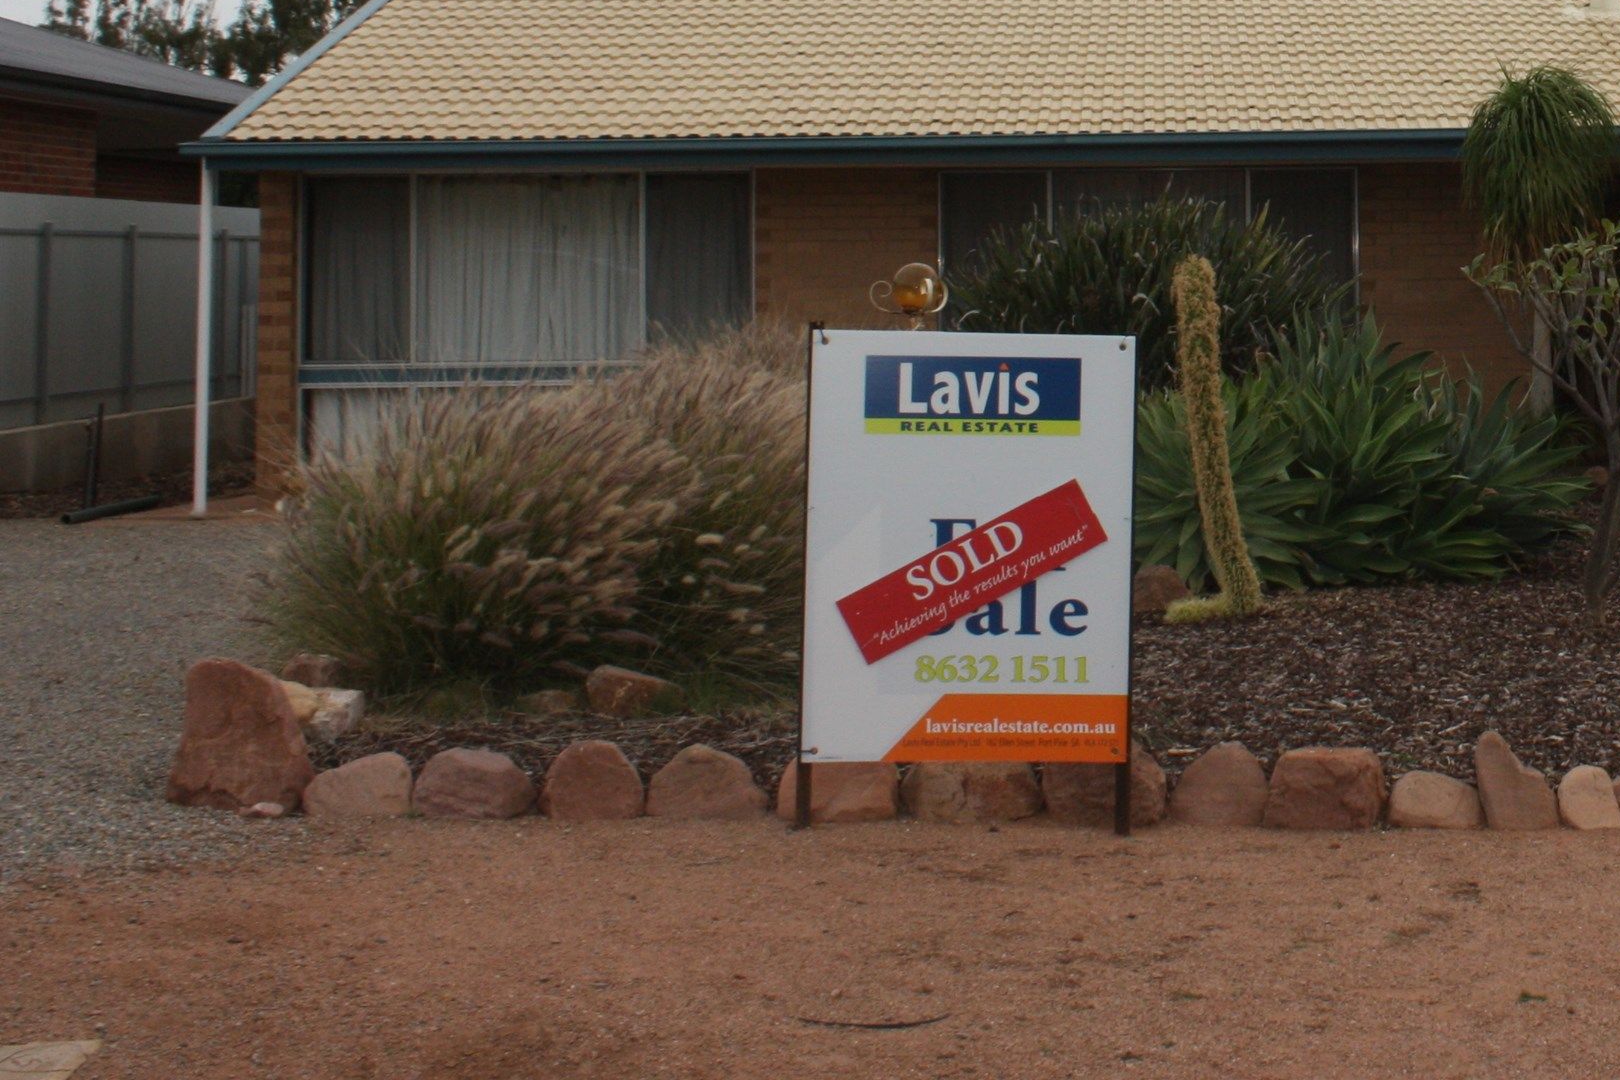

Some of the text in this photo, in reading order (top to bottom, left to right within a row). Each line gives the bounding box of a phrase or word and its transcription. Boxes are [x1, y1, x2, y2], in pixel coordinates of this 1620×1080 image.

[899, 362, 1040, 416] Lavis
[901, 421, 1039, 434] REAL ESTATE
[906, 521, 1023, 601] SOLD
[949, 590, 971, 607] the
[974, 564, 1018, 593] results
[1021, 552, 1046, 579] you
[926, 579, 1090, 637] ale
[914, 654, 1090, 684] 8632 1511
[926, 717, 1116, 734] lavisrealestate.com.au
